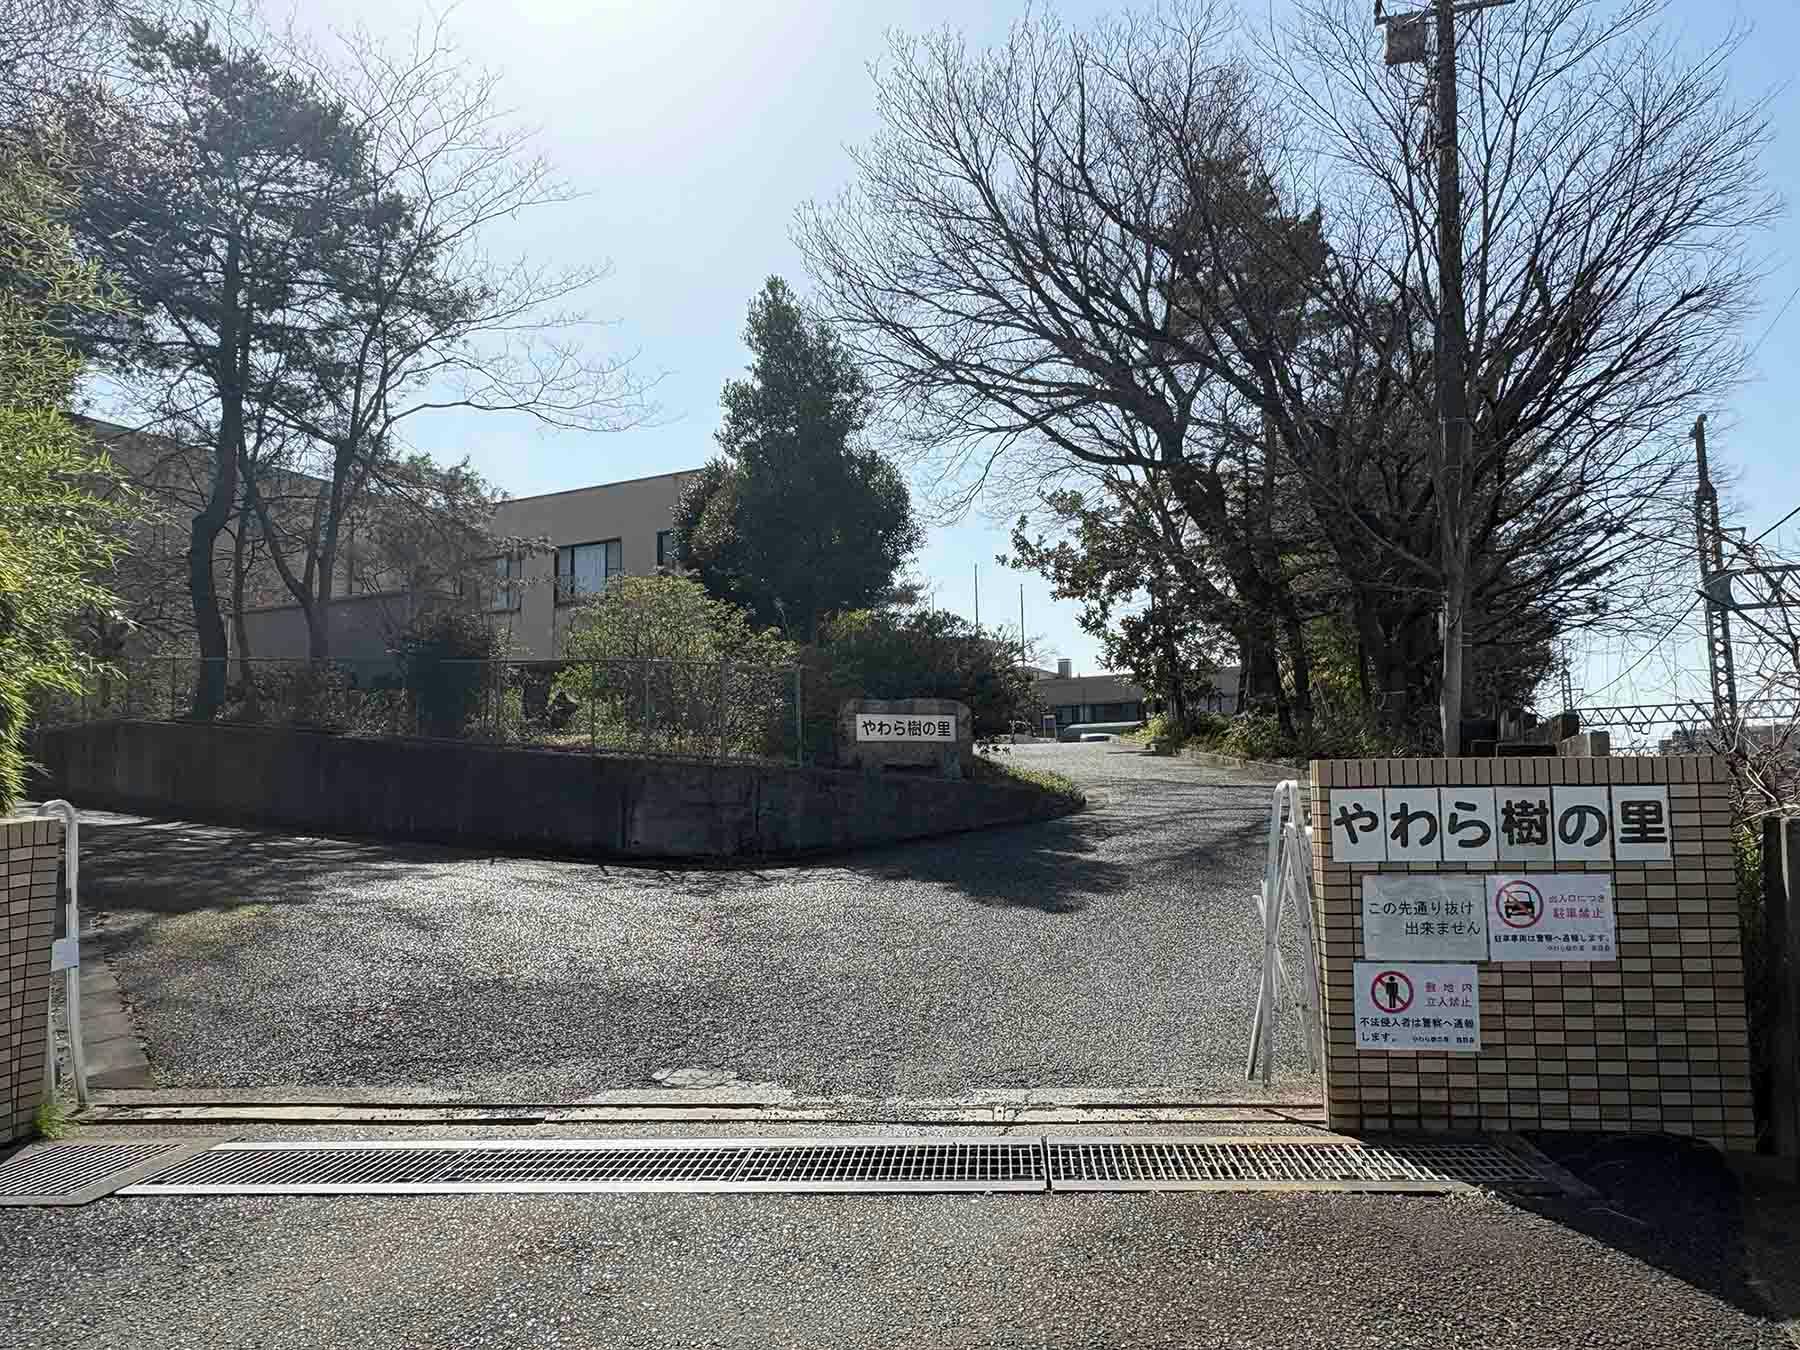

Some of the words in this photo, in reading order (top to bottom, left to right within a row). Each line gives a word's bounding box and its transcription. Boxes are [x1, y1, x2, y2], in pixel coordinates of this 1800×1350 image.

[862, 719, 950, 735] やわら樹の里
[1335, 800, 1666, 847] やわら樹の里
[1368, 900, 1473, 916] この先通り抜け
[1405, 921, 1480, 936] 出来ません
[1425, 997, 1472, 1008] 立入禁止
[1361, 1032, 1397, 1042] します。
